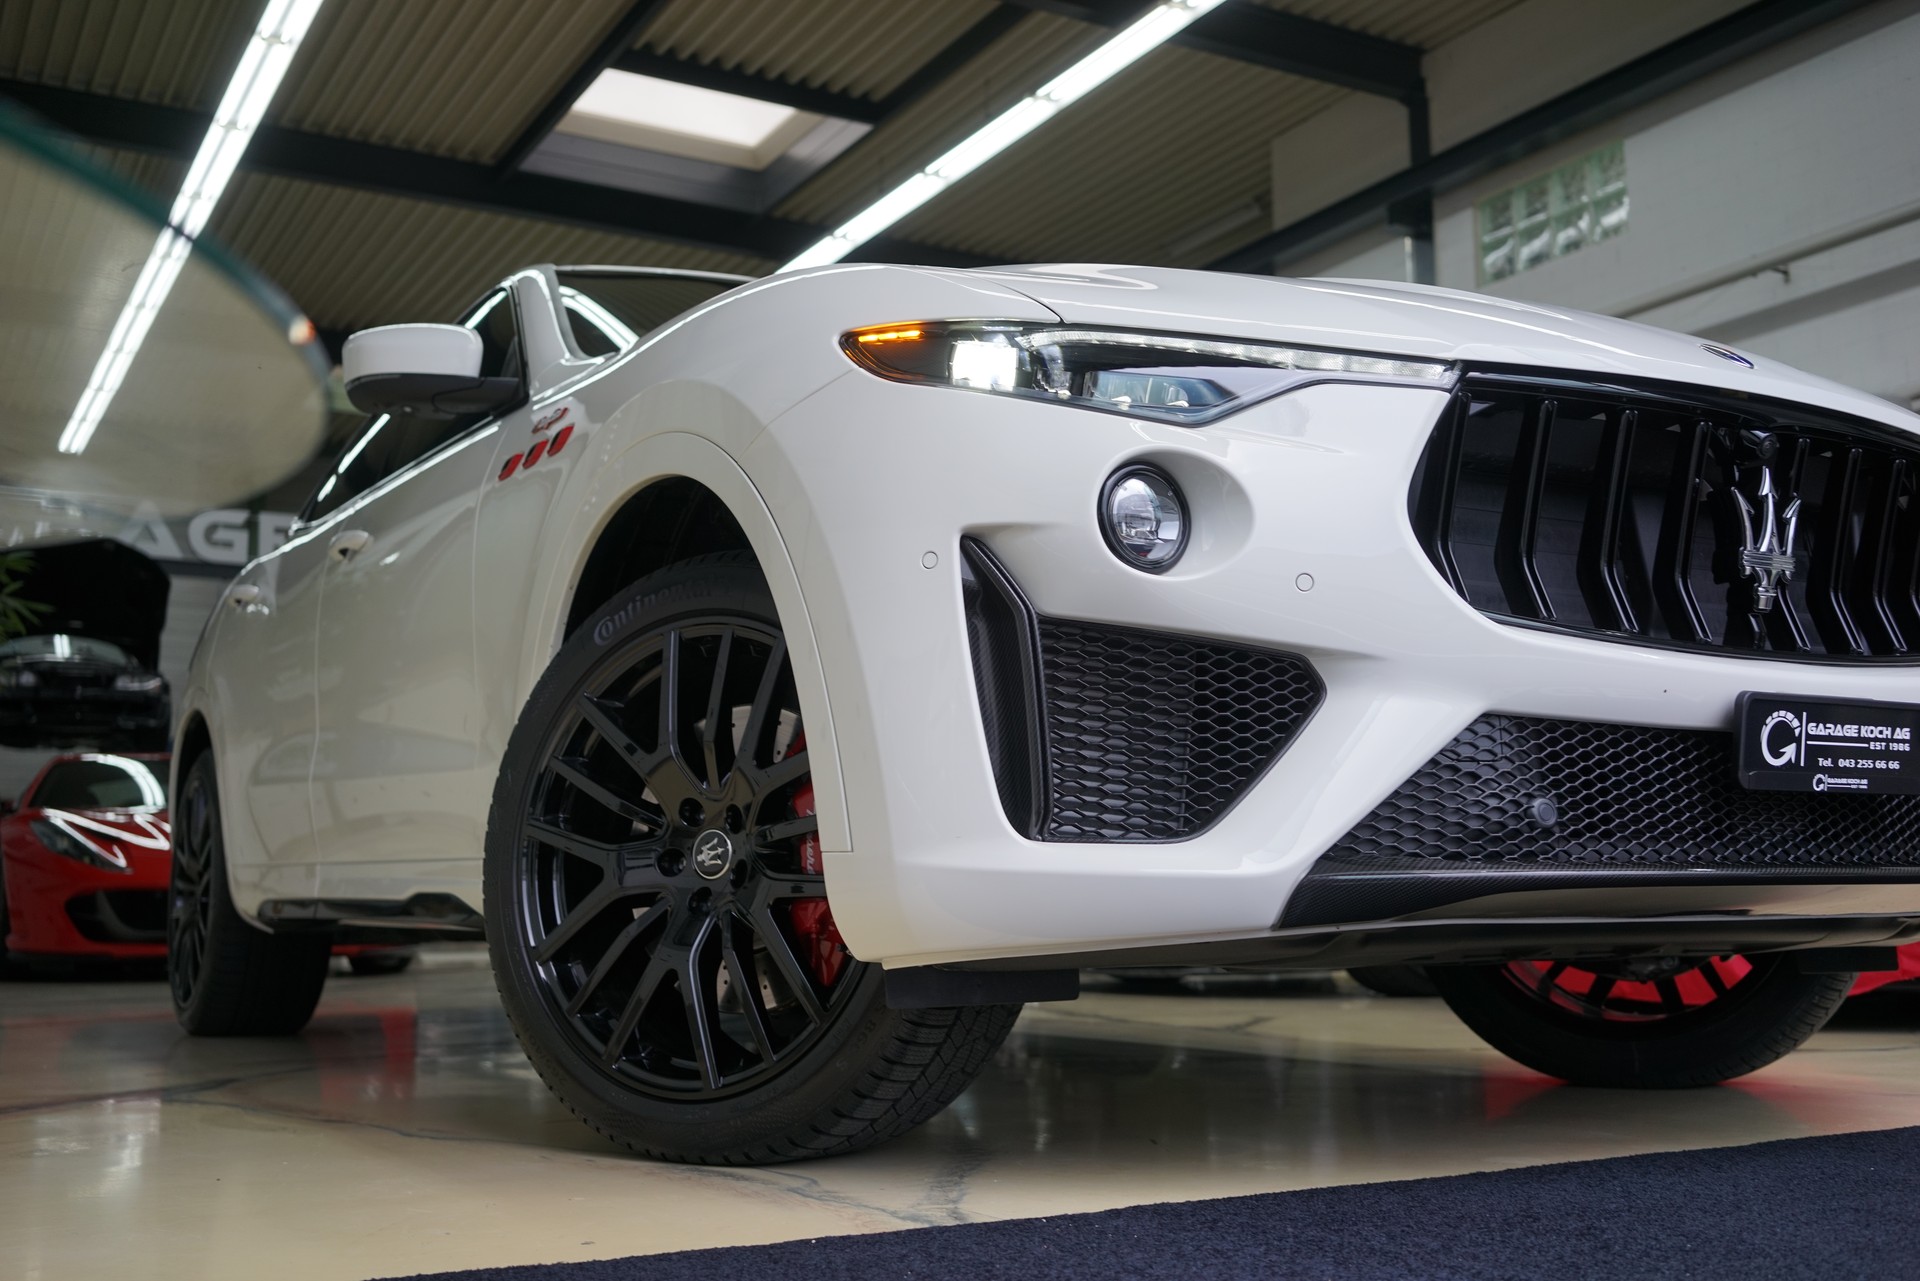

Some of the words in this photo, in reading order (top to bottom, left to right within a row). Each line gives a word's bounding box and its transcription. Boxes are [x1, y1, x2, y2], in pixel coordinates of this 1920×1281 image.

[1807, 722, 1859, 738] GARAGE
[1860, 725, 1892, 740] KOCH
[1893, 727, 1911, 741] AG
[1869, 741, 1886, 750] EST
[1889, 742, 1911, 752] 1986
[1817, 757, 1834, 767] Tel.
[1838, 758, 1855, 768] 043
[1857, 759, 1874, 769] 255
[1875, 759, 1888, 769] 66
[1888, 760, 1900, 770] 66
